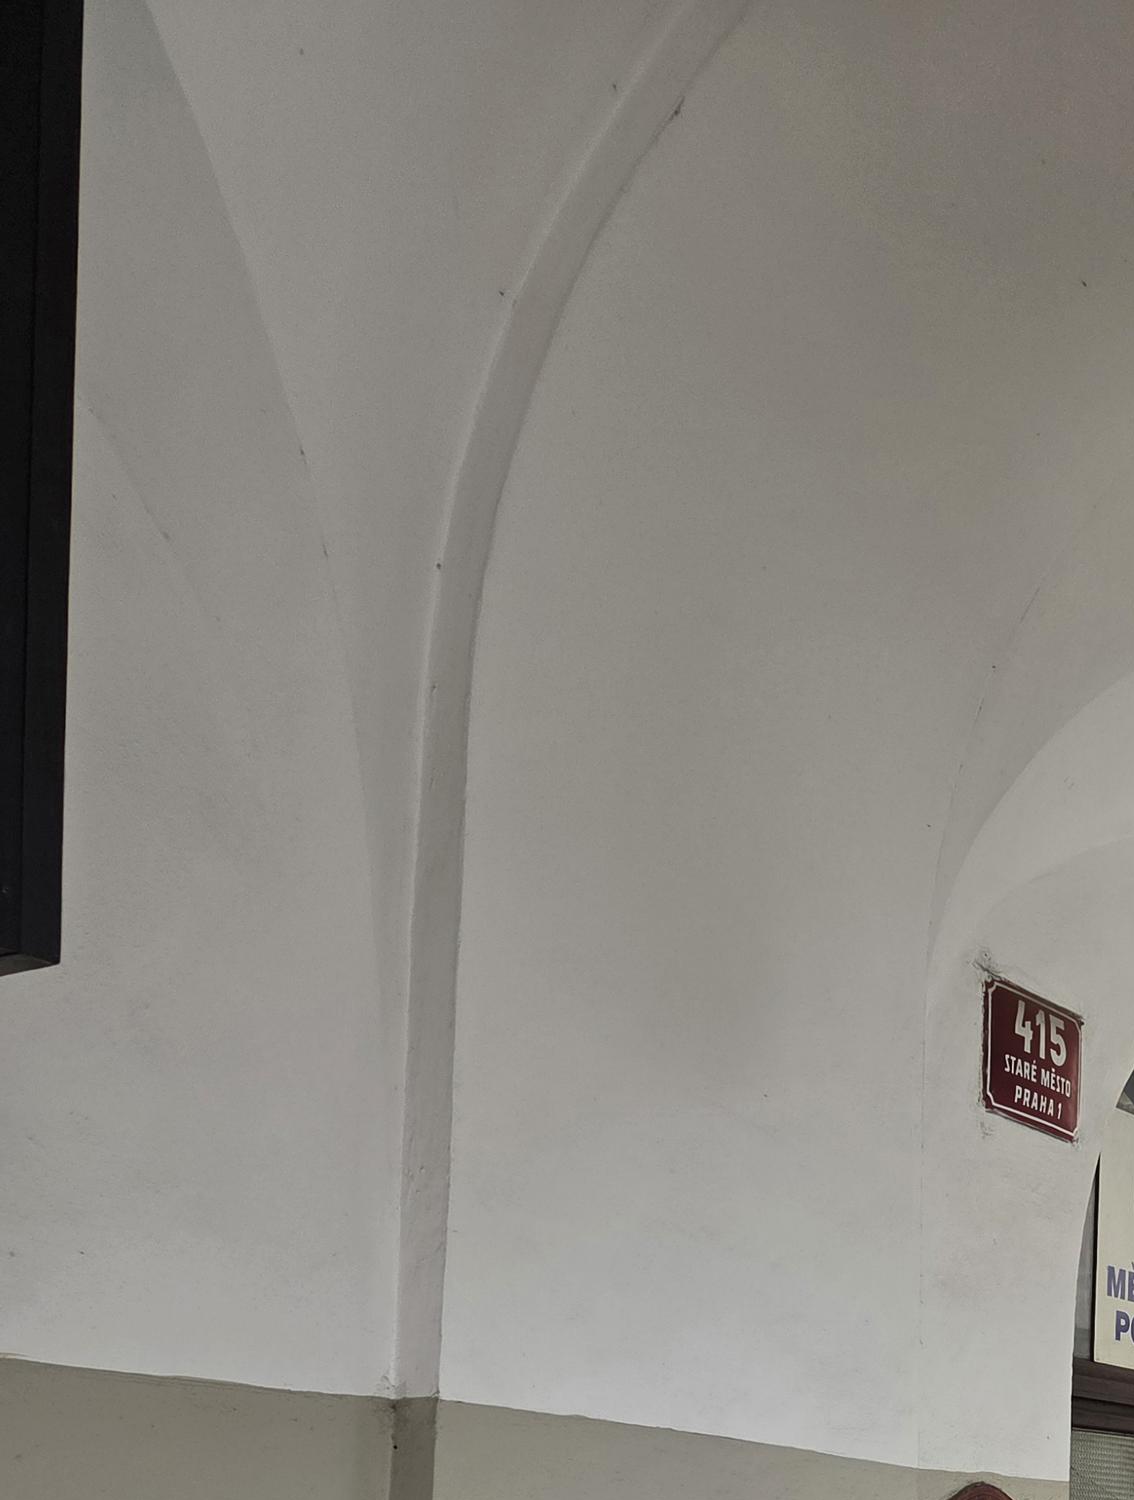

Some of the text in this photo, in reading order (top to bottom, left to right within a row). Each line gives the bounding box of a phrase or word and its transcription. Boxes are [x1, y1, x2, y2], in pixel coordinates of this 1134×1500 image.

[1014, 999, 1067, 1067] 415
[1004, 1053, 1071, 1099] STARÉ MĚSTO
[1014, 1085, 1063, 1120] PRAHA 1
